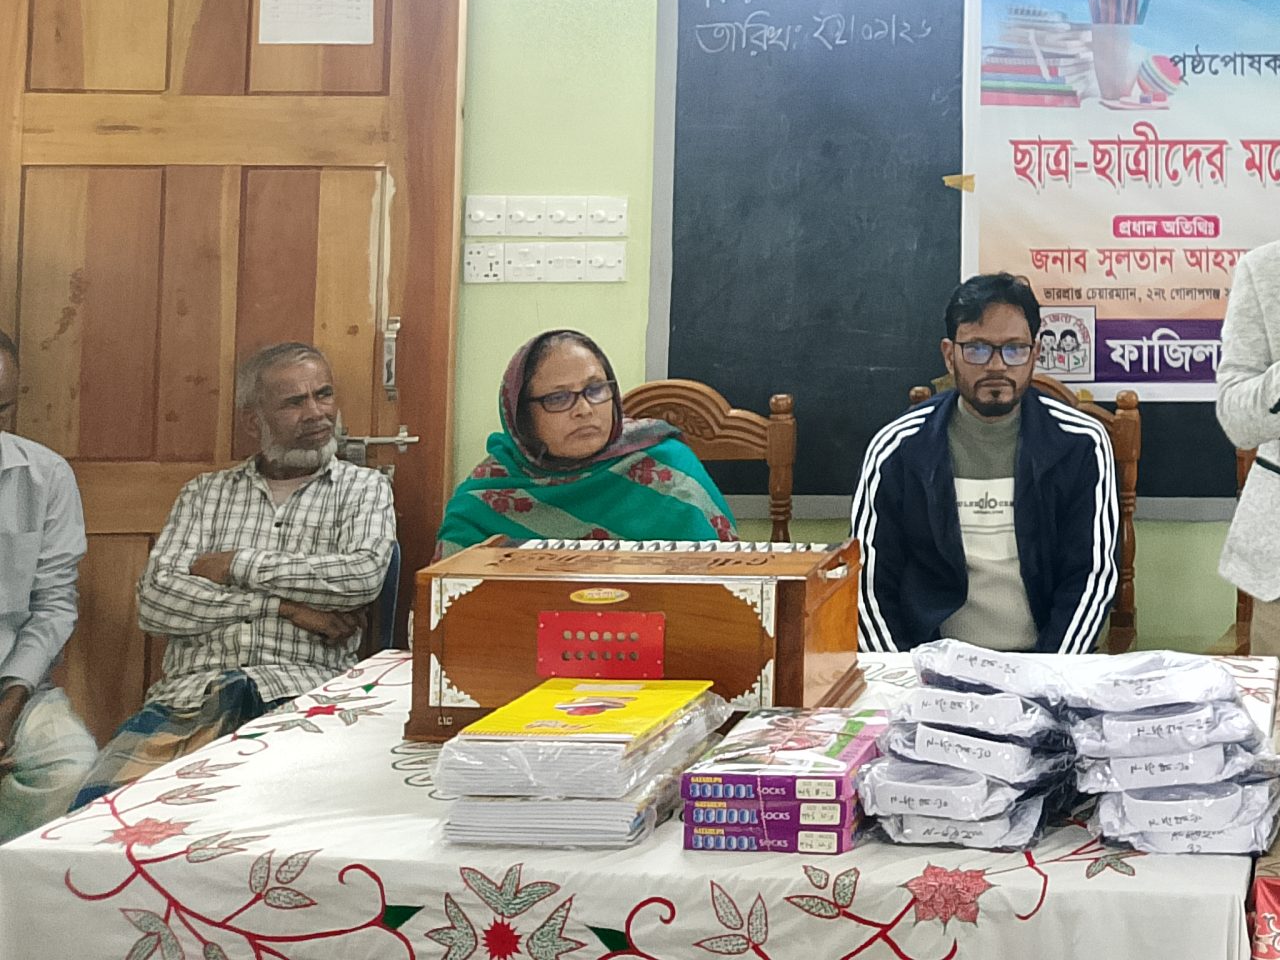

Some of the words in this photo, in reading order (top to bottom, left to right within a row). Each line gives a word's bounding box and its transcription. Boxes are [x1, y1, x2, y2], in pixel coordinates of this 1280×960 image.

[1009, 121, 1230, 190] ছাত্র-ছাত্রীদের
[1118, 218, 1157, 237] প্রধান
[1029, 246, 1089, 274] জনাব
[1095, 246, 1176, 280] সুলতান
[1182, 245, 1250, 275] আহম
[1146, 288, 1167, 302] ২নং
[1106, 327, 1224, 374] ফাজিল
